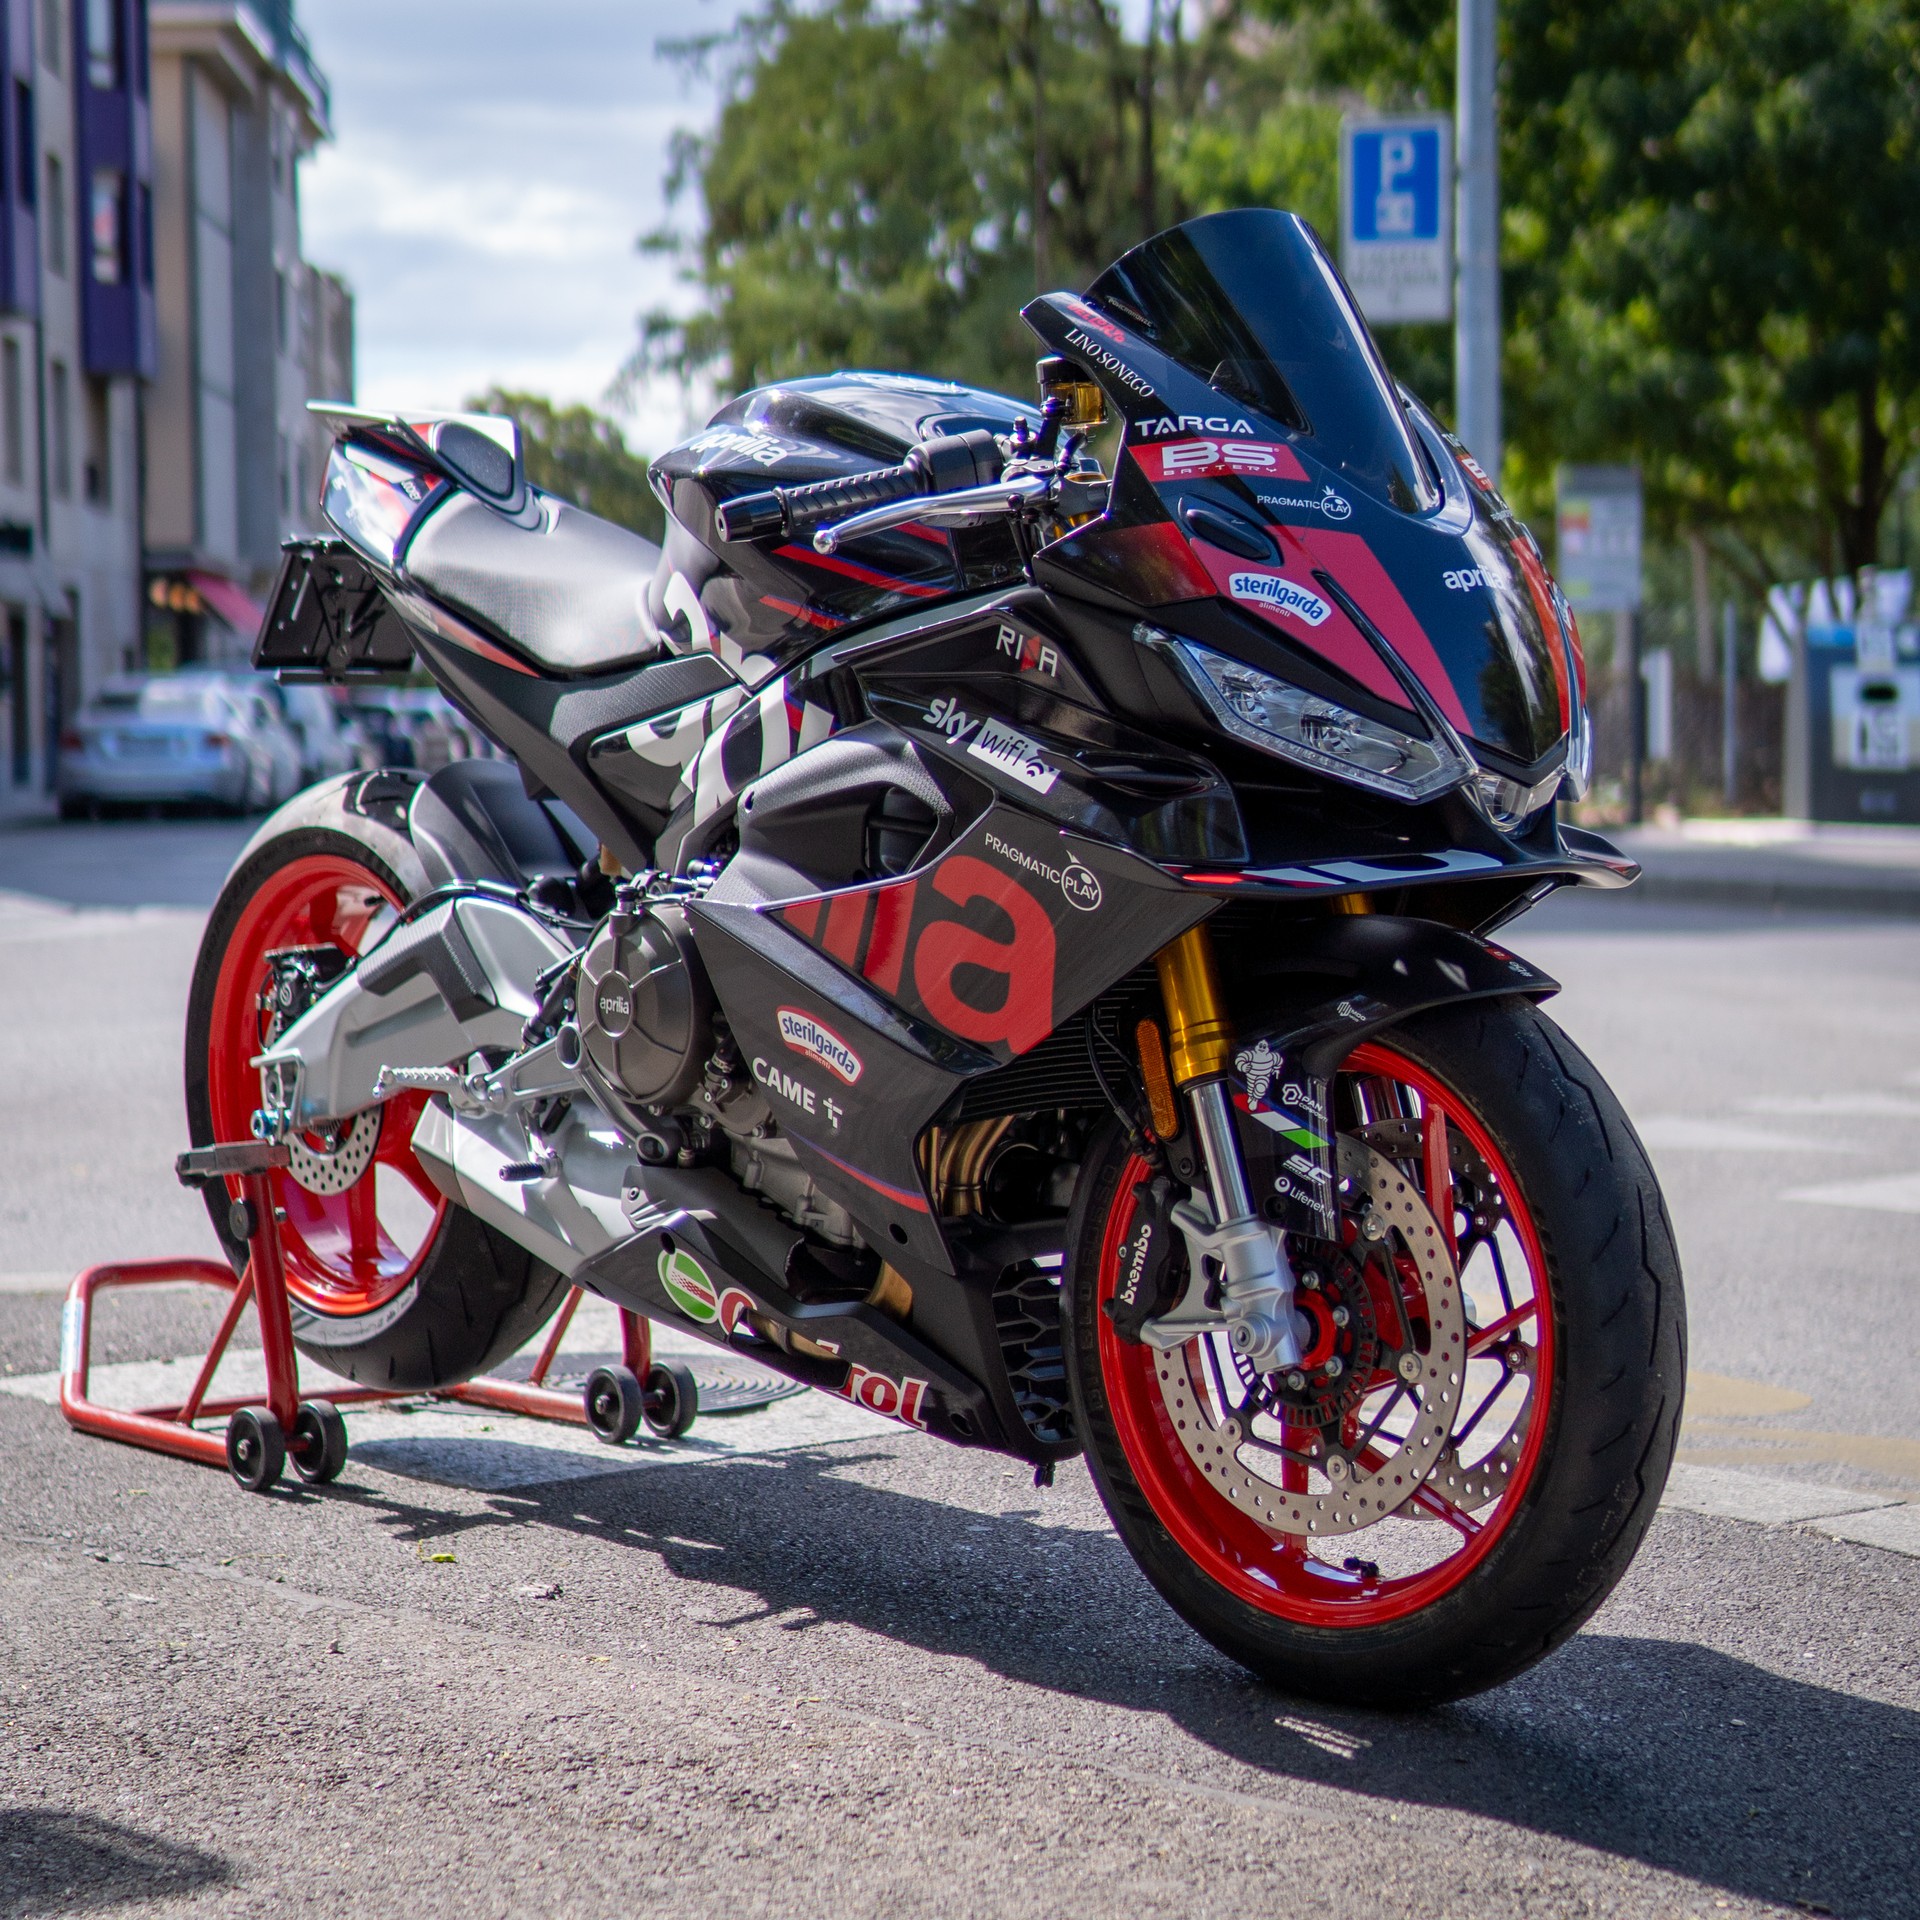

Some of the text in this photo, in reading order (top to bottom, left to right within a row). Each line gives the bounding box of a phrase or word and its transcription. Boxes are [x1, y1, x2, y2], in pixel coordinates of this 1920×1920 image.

[1380, 135, 1416, 193] P
[1064, 328, 1155, 398] LINO SONEGO
[1134, 415, 1255, 437] TARGA
[1161, 441, 1277, 469] BS
[1163, 464, 1277, 476] BATTERY
[1256, 495, 1349, 514] PRAGMATIC PLAY
[1442, 563, 1506, 593] aprilia
[1234, 576, 1324, 620] sterilgarda
[1258, 601, 1291, 617] alimenti
[922, 697, 1029, 766] sky wifi
[985, 832, 1098, 900] PRAGMATIC PLAY
[599, 995, 630, 1015] aprilia
[782, 1016, 855, 1075] sterilgarda
[804, 1049, 831, 1070] alimenti
[752, 1057, 816, 1115] CAME
[1301, 1095, 1323, 1112] PAN
[1286, 1154, 1333, 1185] SC
[1120, 1223, 1152, 1305] brembo
